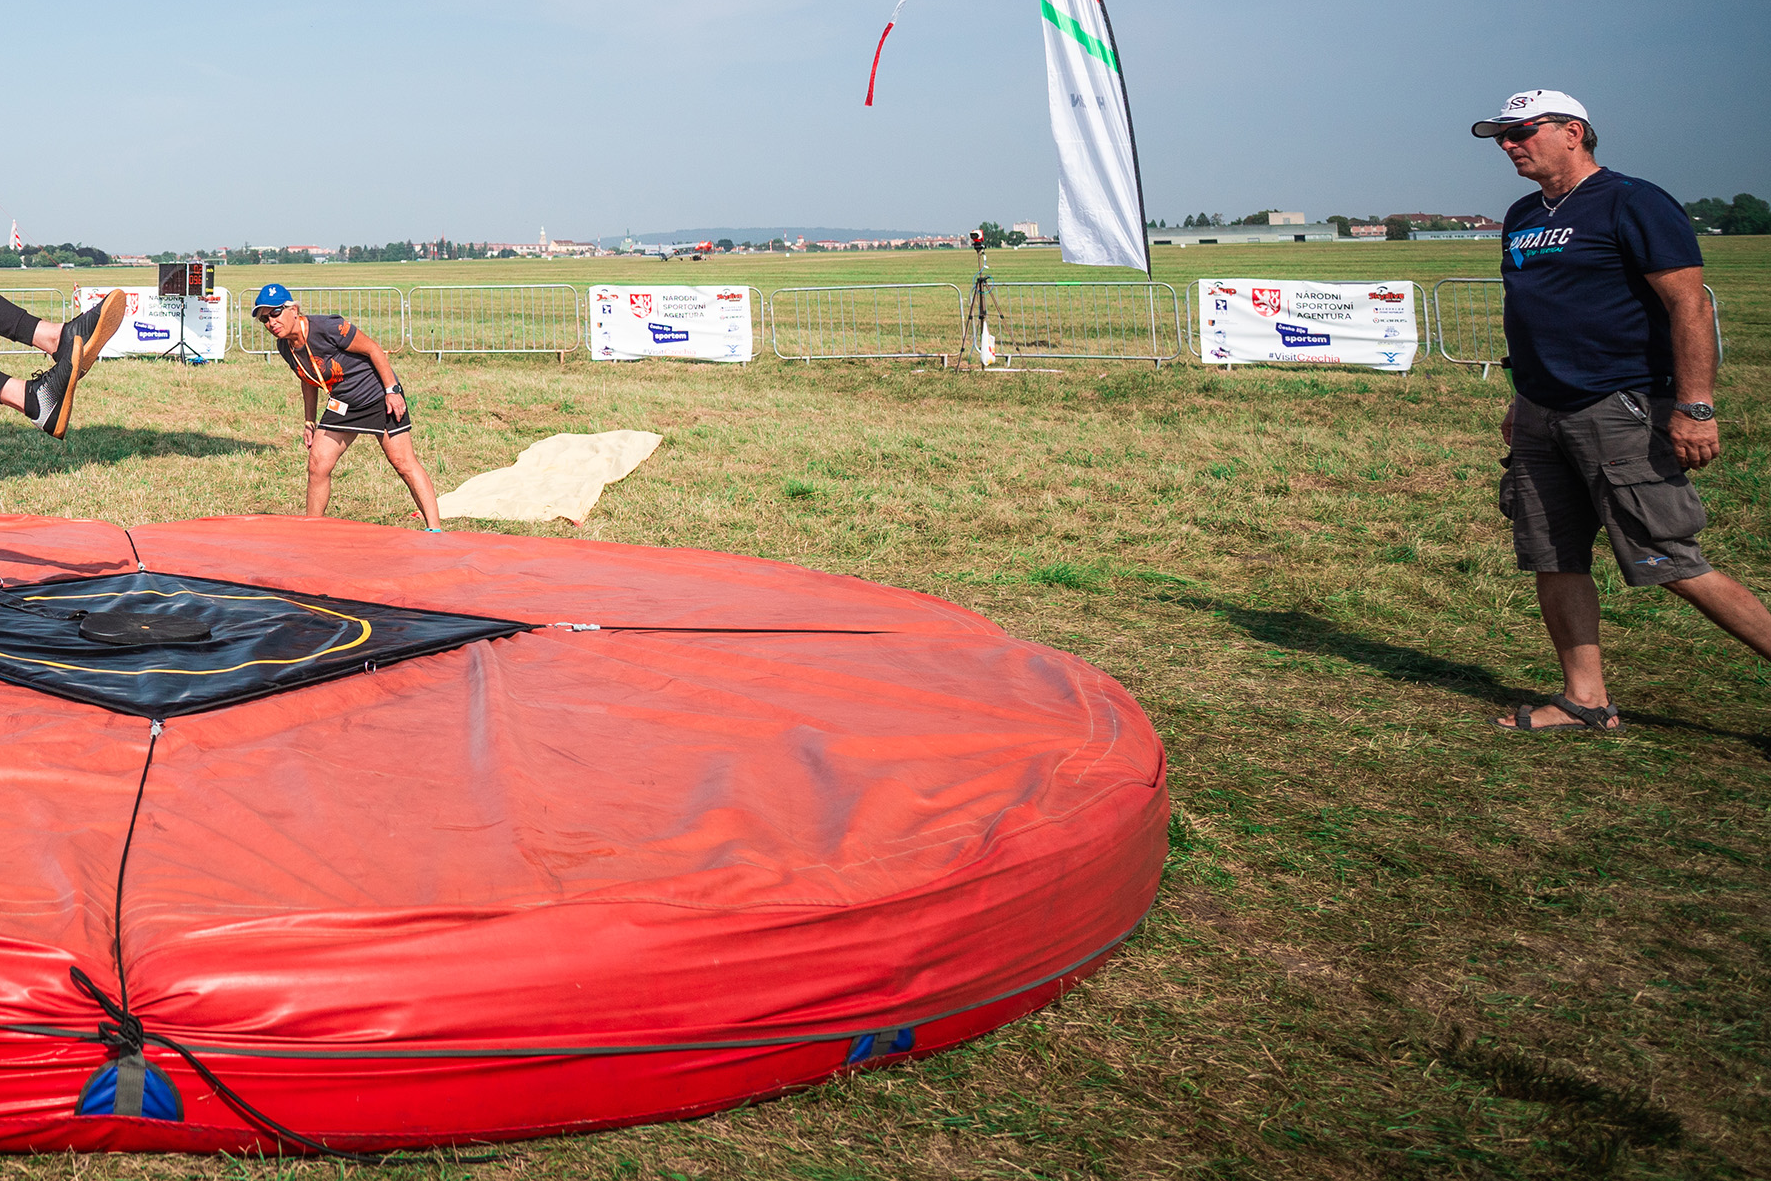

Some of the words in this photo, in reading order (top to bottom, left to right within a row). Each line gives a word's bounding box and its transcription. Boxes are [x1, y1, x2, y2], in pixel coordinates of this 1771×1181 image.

[1509, 227, 1573, 250] PARATEC
[1295, 301, 1354, 311] SPORTOVNÍ
[1297, 312, 1352, 320] AGENTURA
[654, 333, 687, 341] sportem
[1284, 335, 1328, 344] sportem
[1269, 352, 1341, 363] #VisitCzechia
